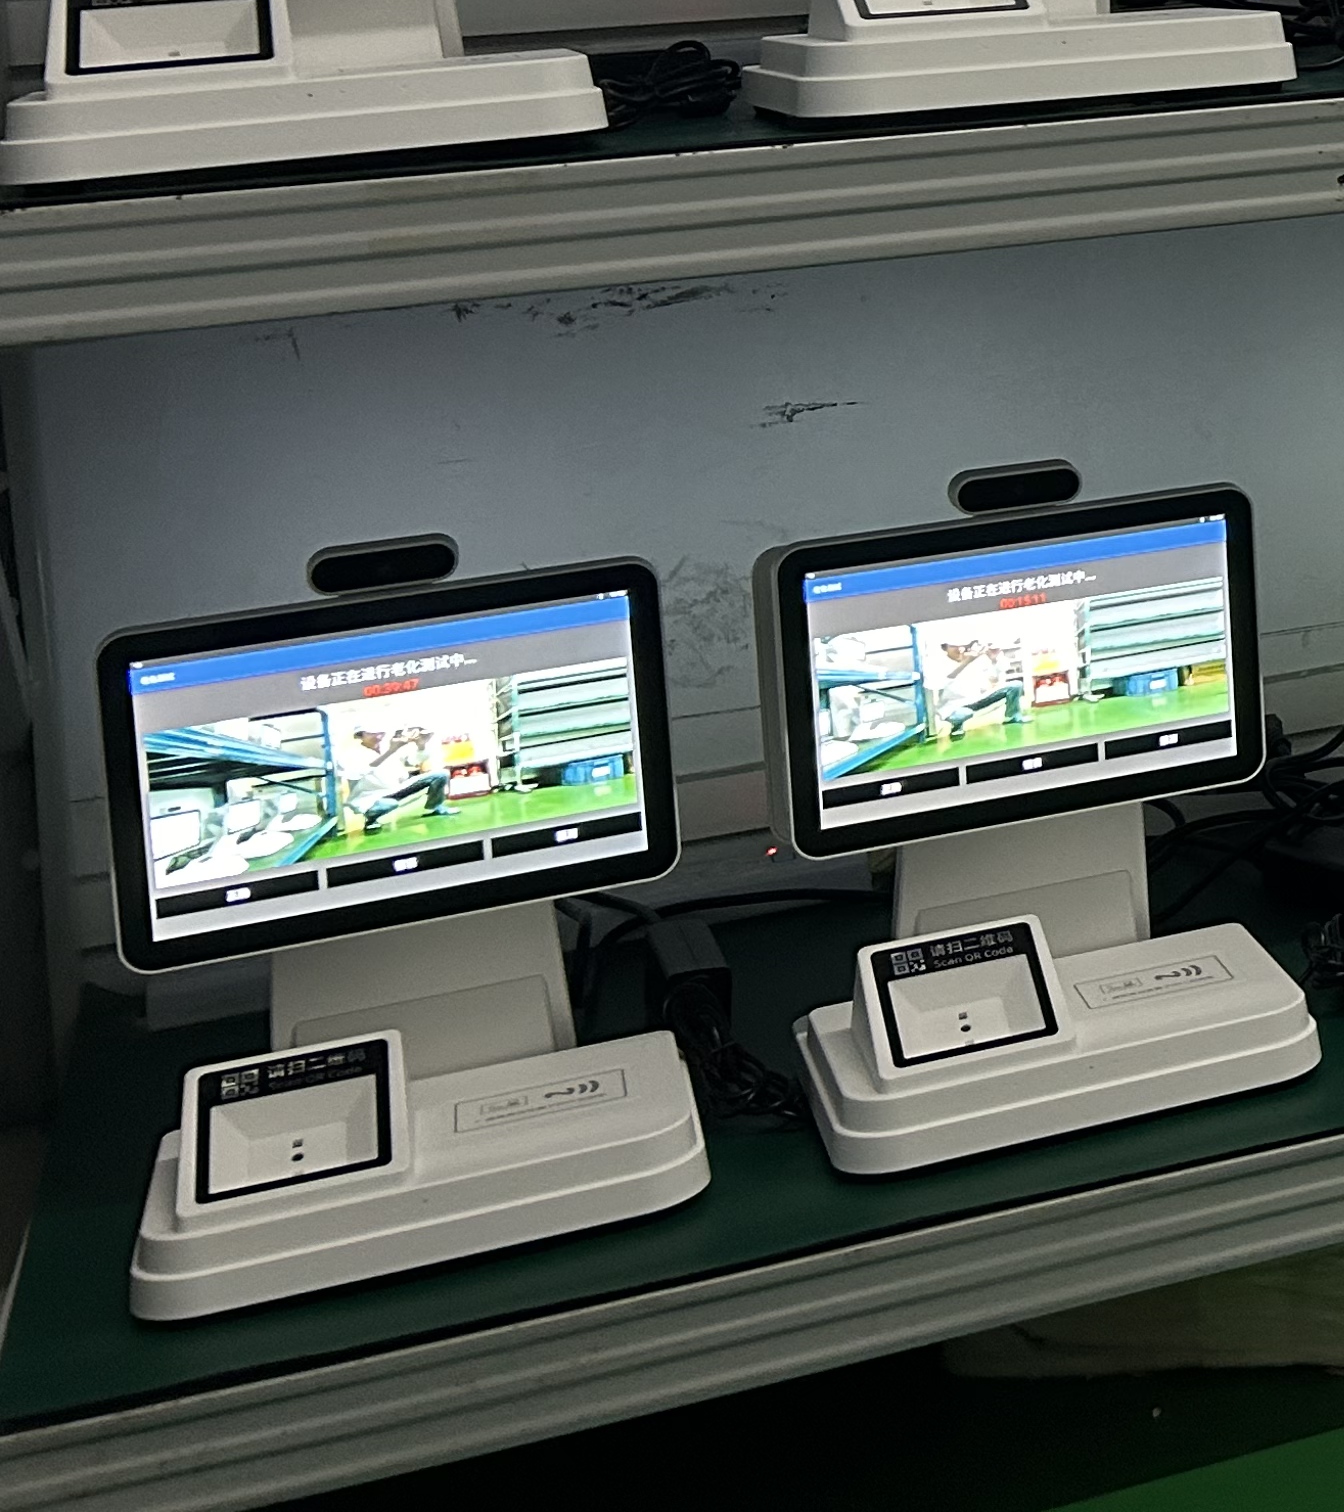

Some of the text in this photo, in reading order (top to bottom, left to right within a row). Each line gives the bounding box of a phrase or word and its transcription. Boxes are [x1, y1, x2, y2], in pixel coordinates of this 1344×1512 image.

[930, 930, 1013, 957] 请扫二维码
[933, 945, 1014, 969] Scan QR Code
